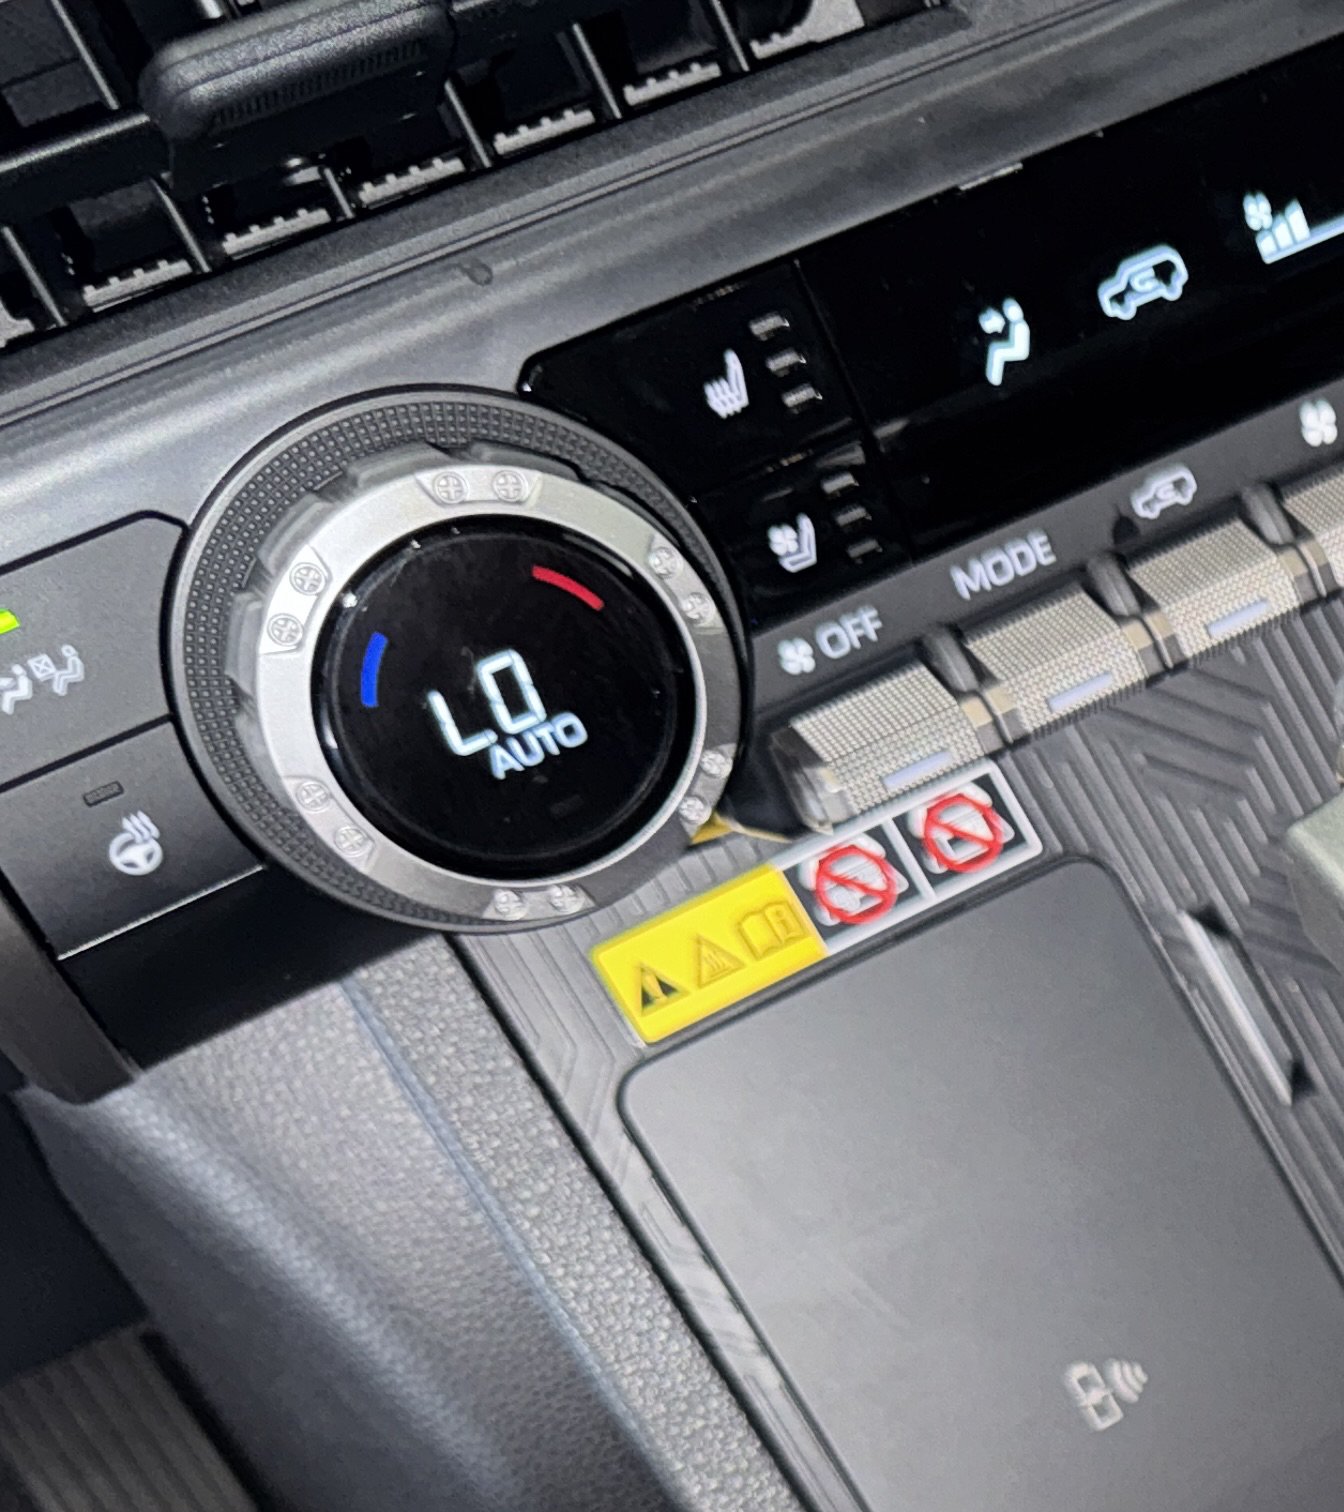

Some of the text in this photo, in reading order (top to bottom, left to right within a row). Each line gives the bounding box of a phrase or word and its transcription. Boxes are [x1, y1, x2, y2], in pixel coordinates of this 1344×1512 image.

[950, 533, 1055, 600] MODE
[815, 606, 883, 659] OFF
[488, 712, 588, 780] AUTO
